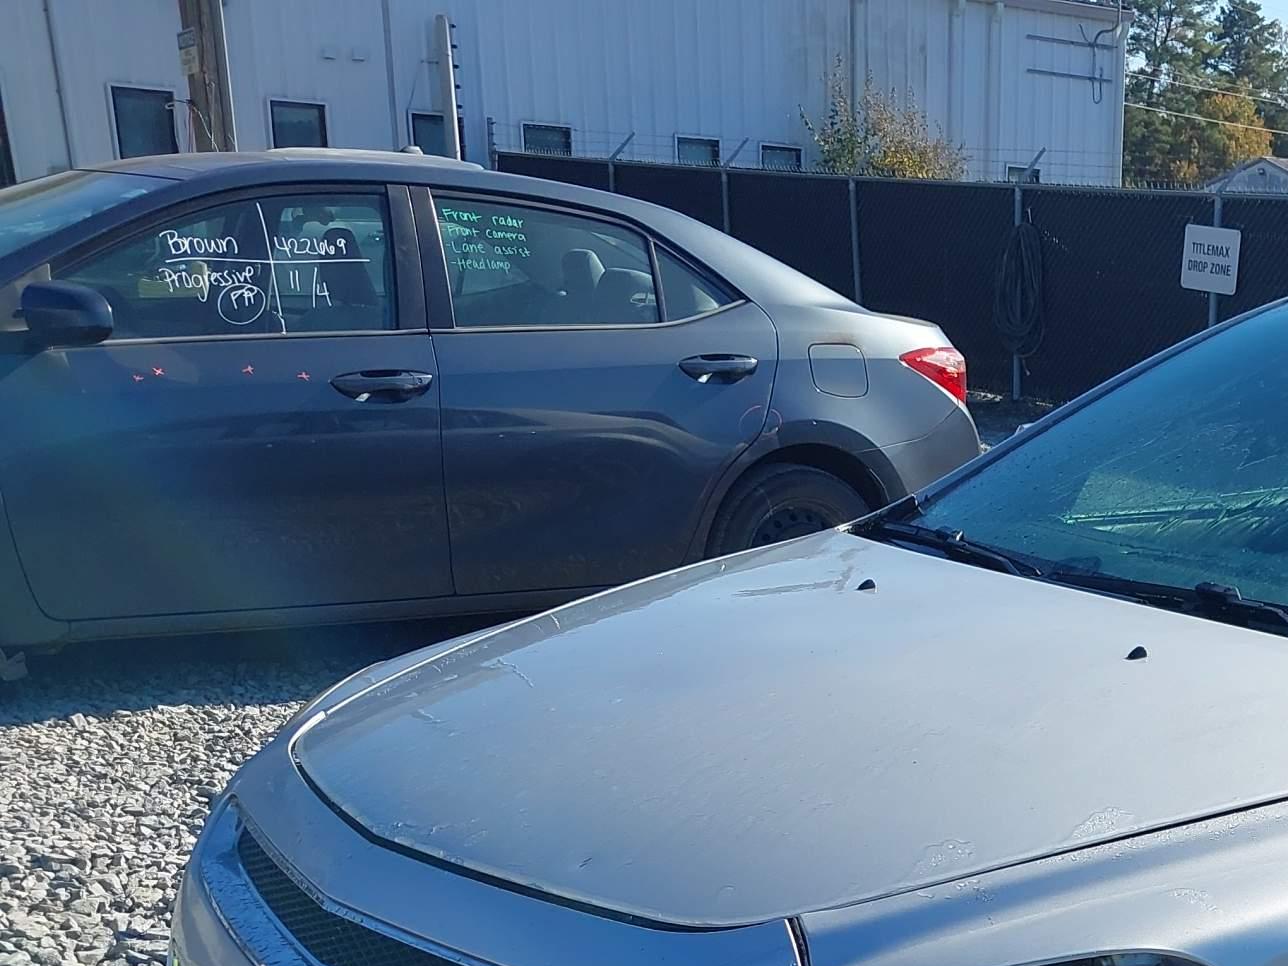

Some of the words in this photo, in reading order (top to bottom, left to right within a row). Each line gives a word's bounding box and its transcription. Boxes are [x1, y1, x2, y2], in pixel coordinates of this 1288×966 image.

[492, 215, 524, 228] radar
[159, 230, 239, 255] Brown
[486, 228, 526, 242] camera
[494, 246, 531, 258] assist
[1192, 241, 1231, 259] TITLEMAX
[1188, 258, 1208, 273] DROP
[1209, 262, 1232, 277] ZONE
[158, 266, 255, 302] Progressive
